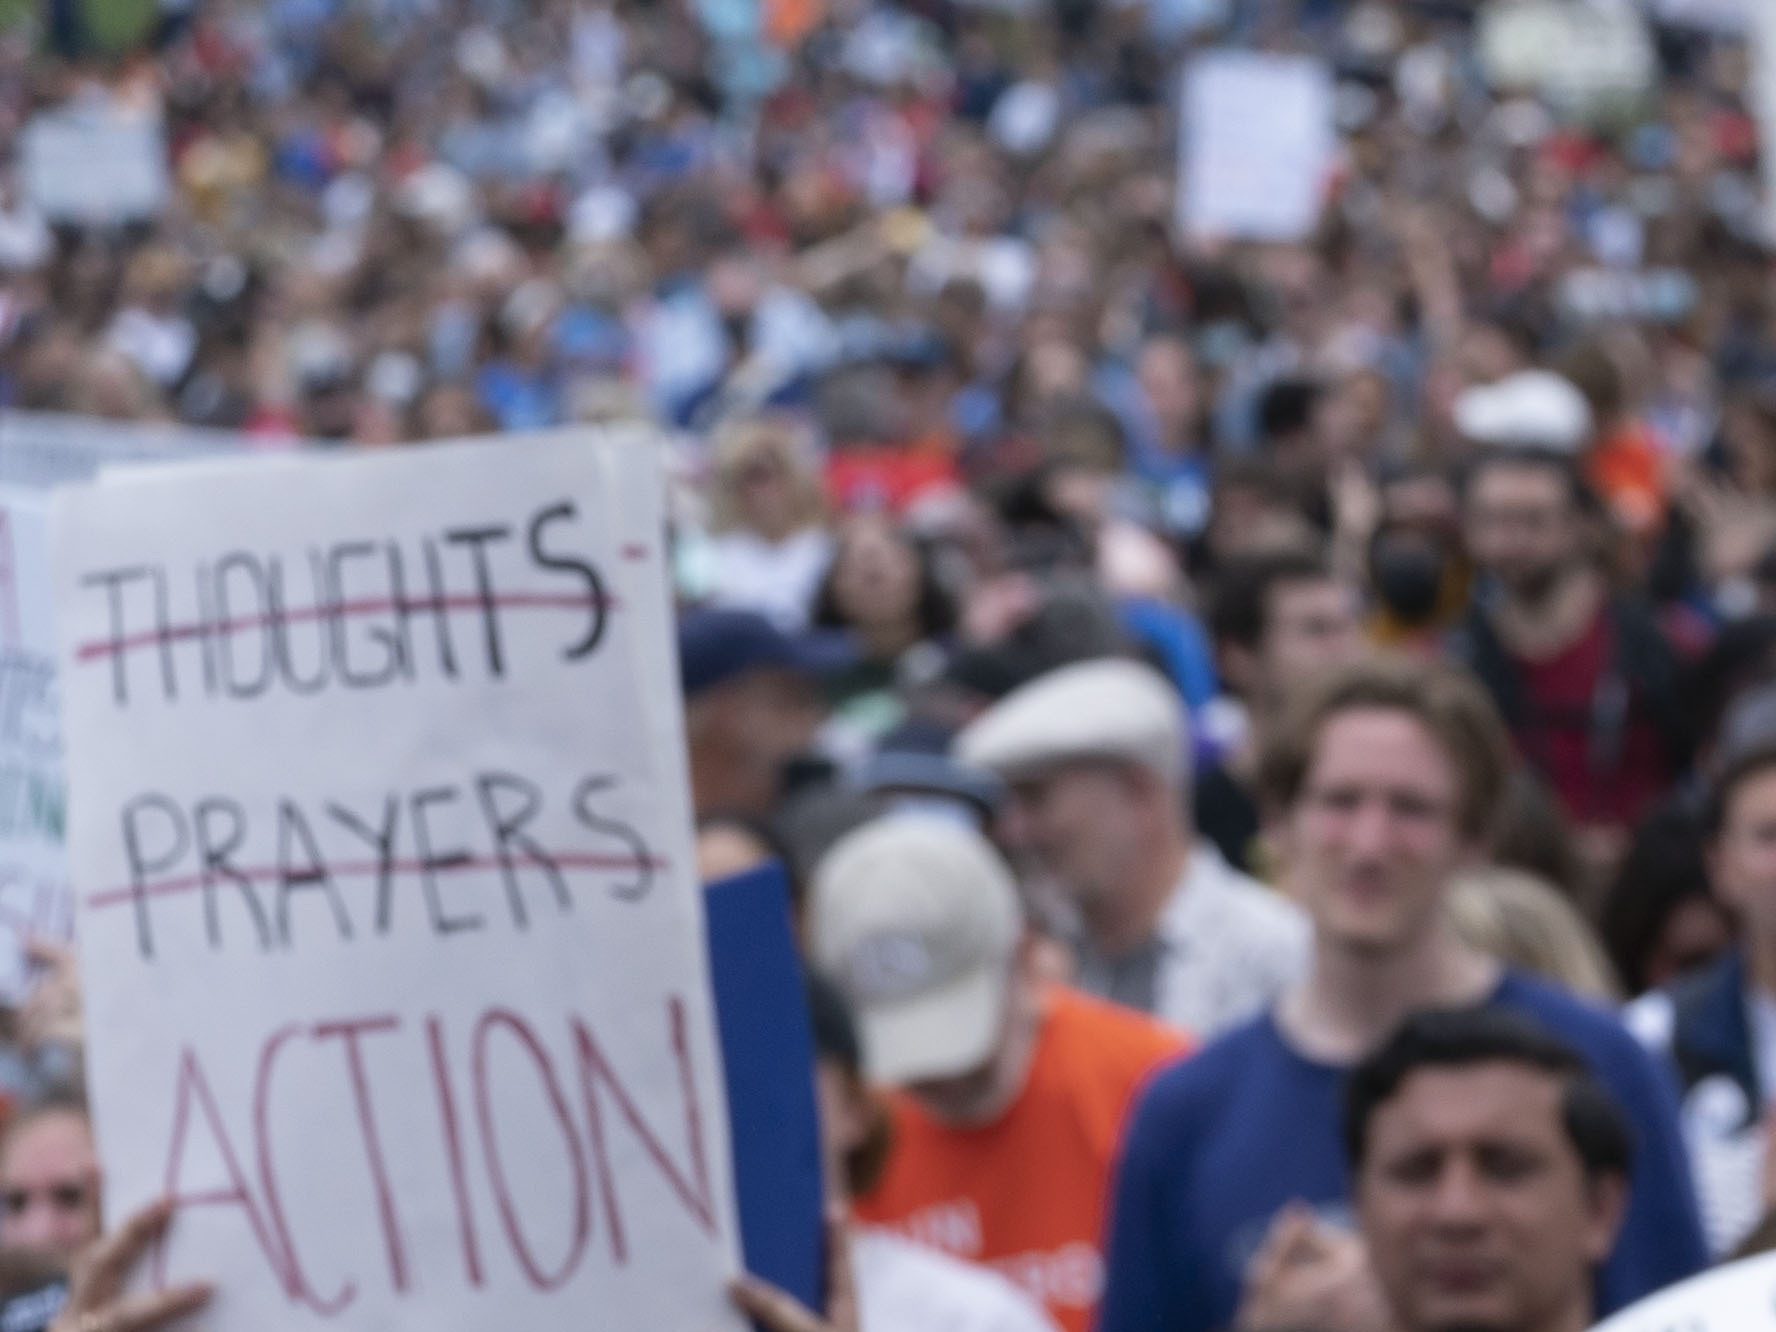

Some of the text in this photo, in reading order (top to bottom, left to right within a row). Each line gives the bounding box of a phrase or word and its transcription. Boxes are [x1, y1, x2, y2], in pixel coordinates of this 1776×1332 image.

[79, 502, 610, 705] THOUGHTS
[120, 770, 655, 963] PRAYERS
[150, 994, 722, 1318] ACTION
